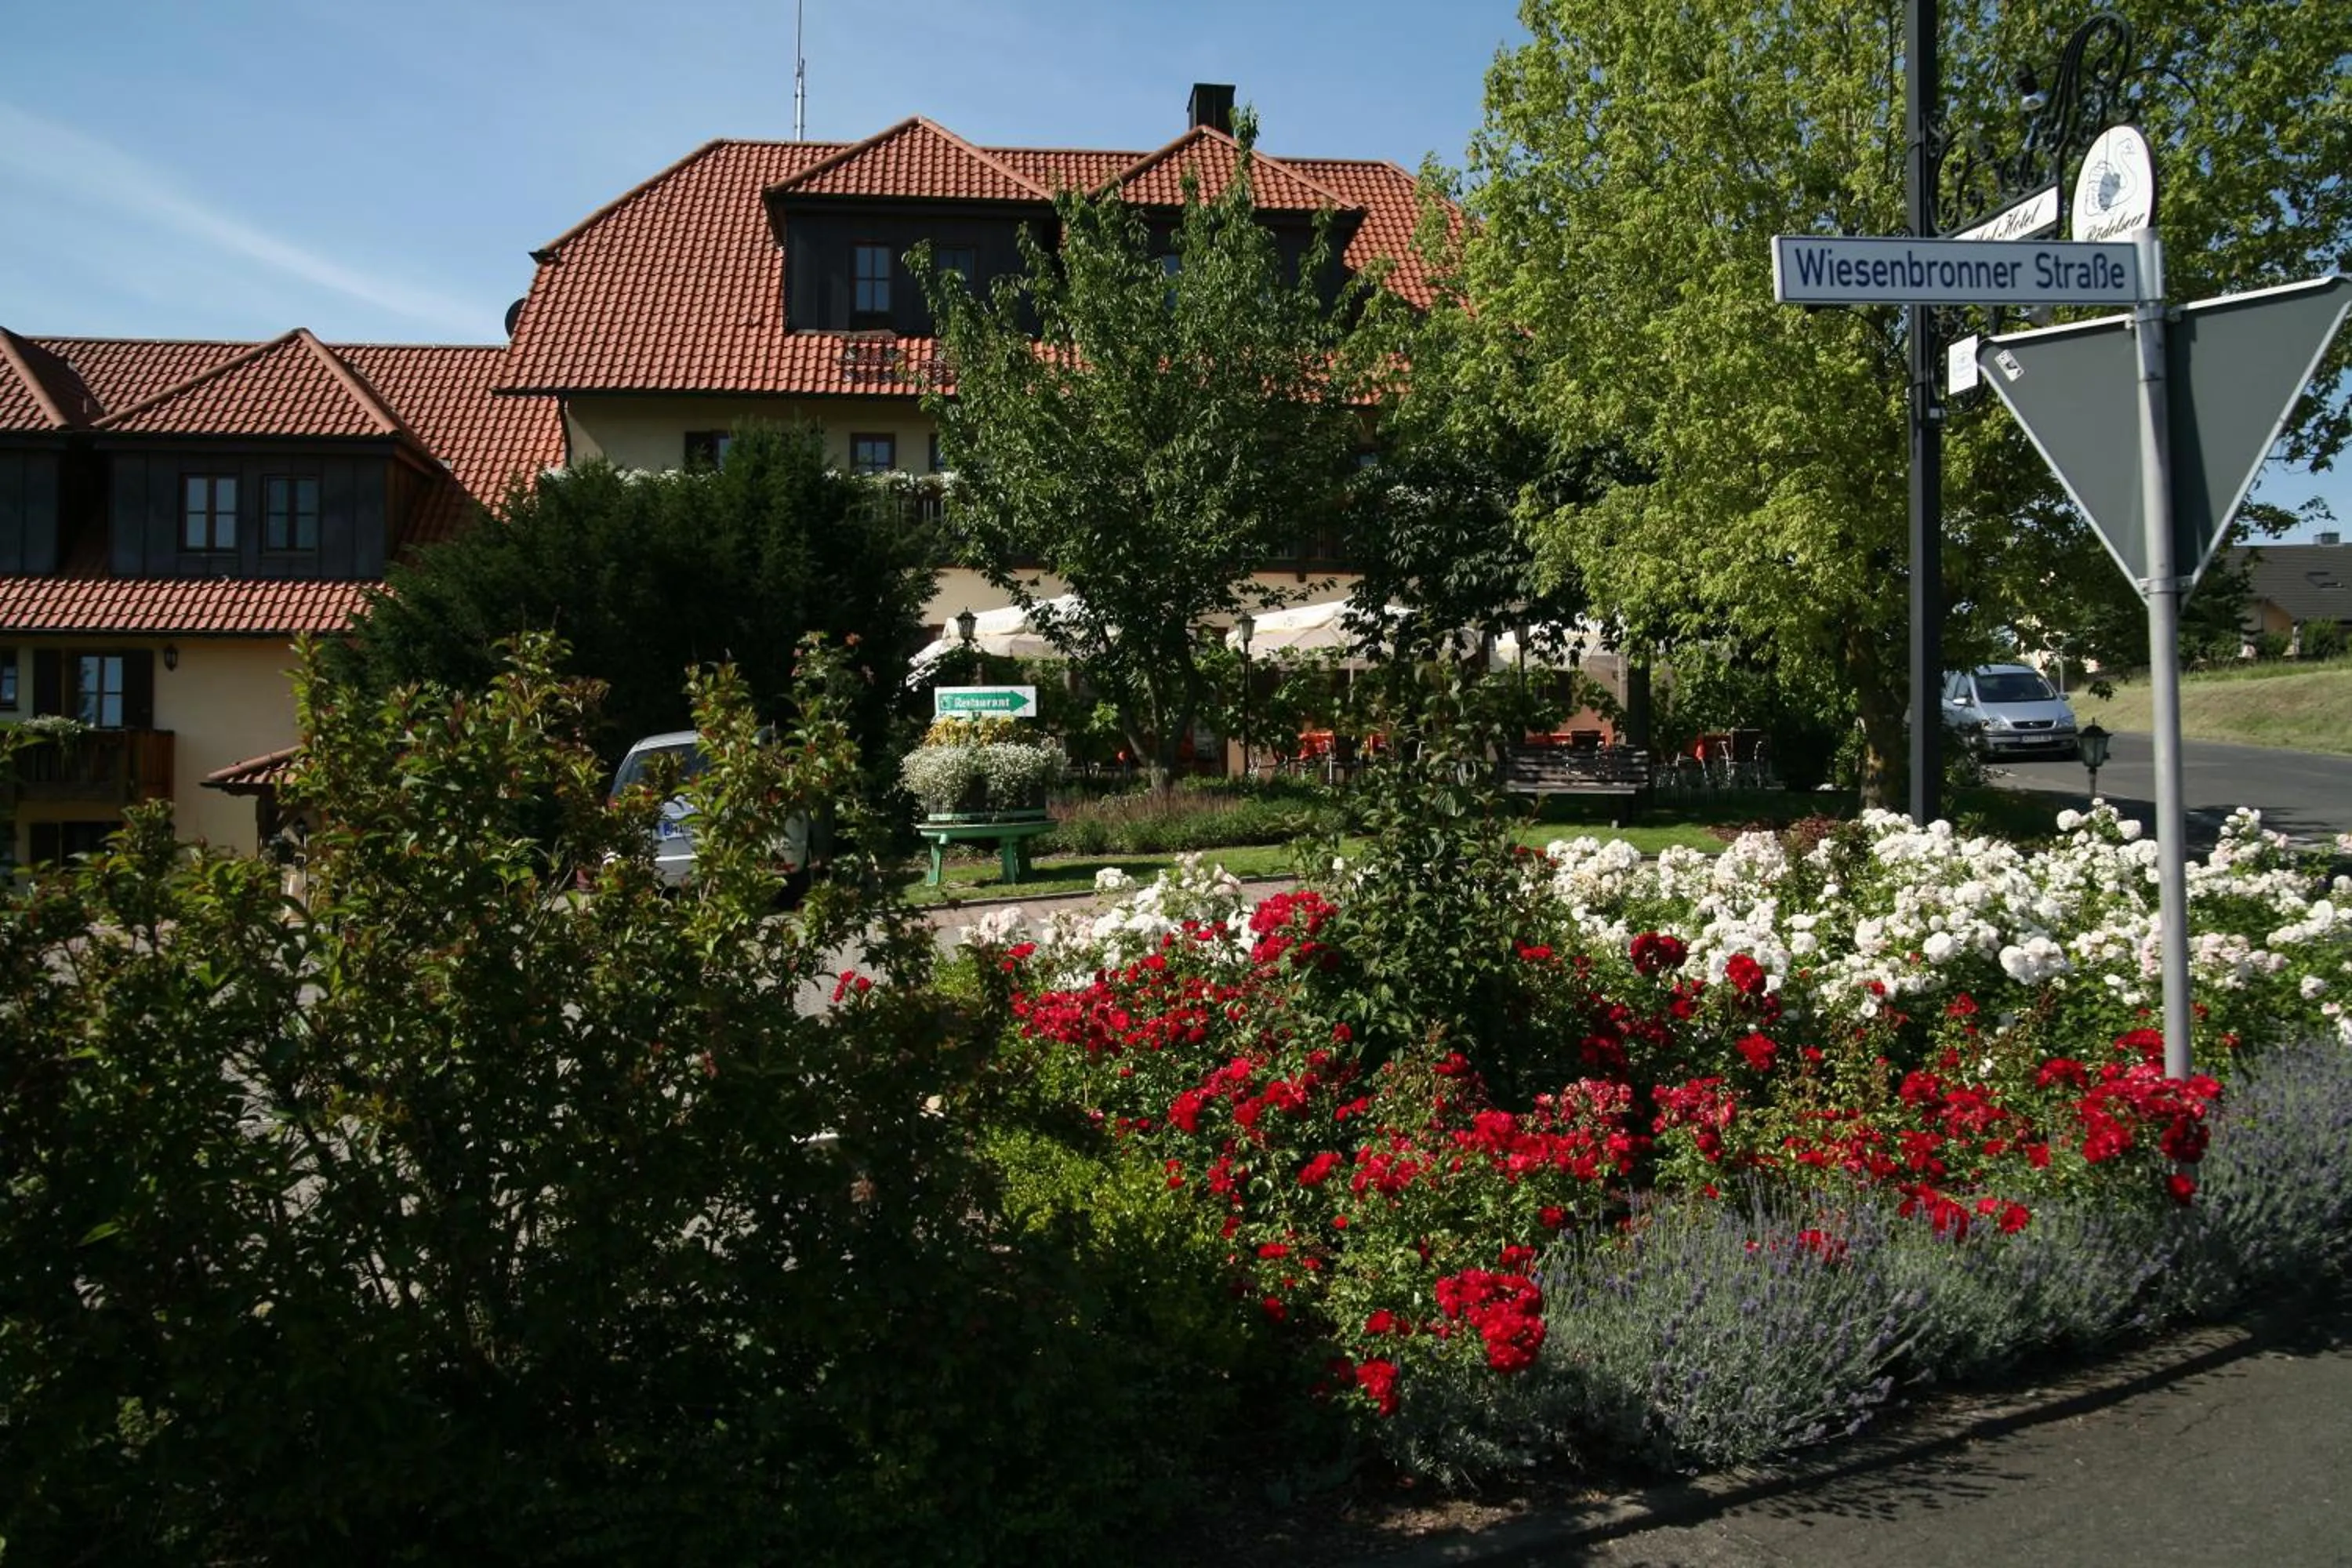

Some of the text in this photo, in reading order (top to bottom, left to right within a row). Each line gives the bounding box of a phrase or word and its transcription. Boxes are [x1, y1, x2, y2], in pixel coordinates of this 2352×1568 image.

[1795, 248, 2125, 289] Wiesenbronner Straße
[953, 696, 1010, 708] Restaurant
